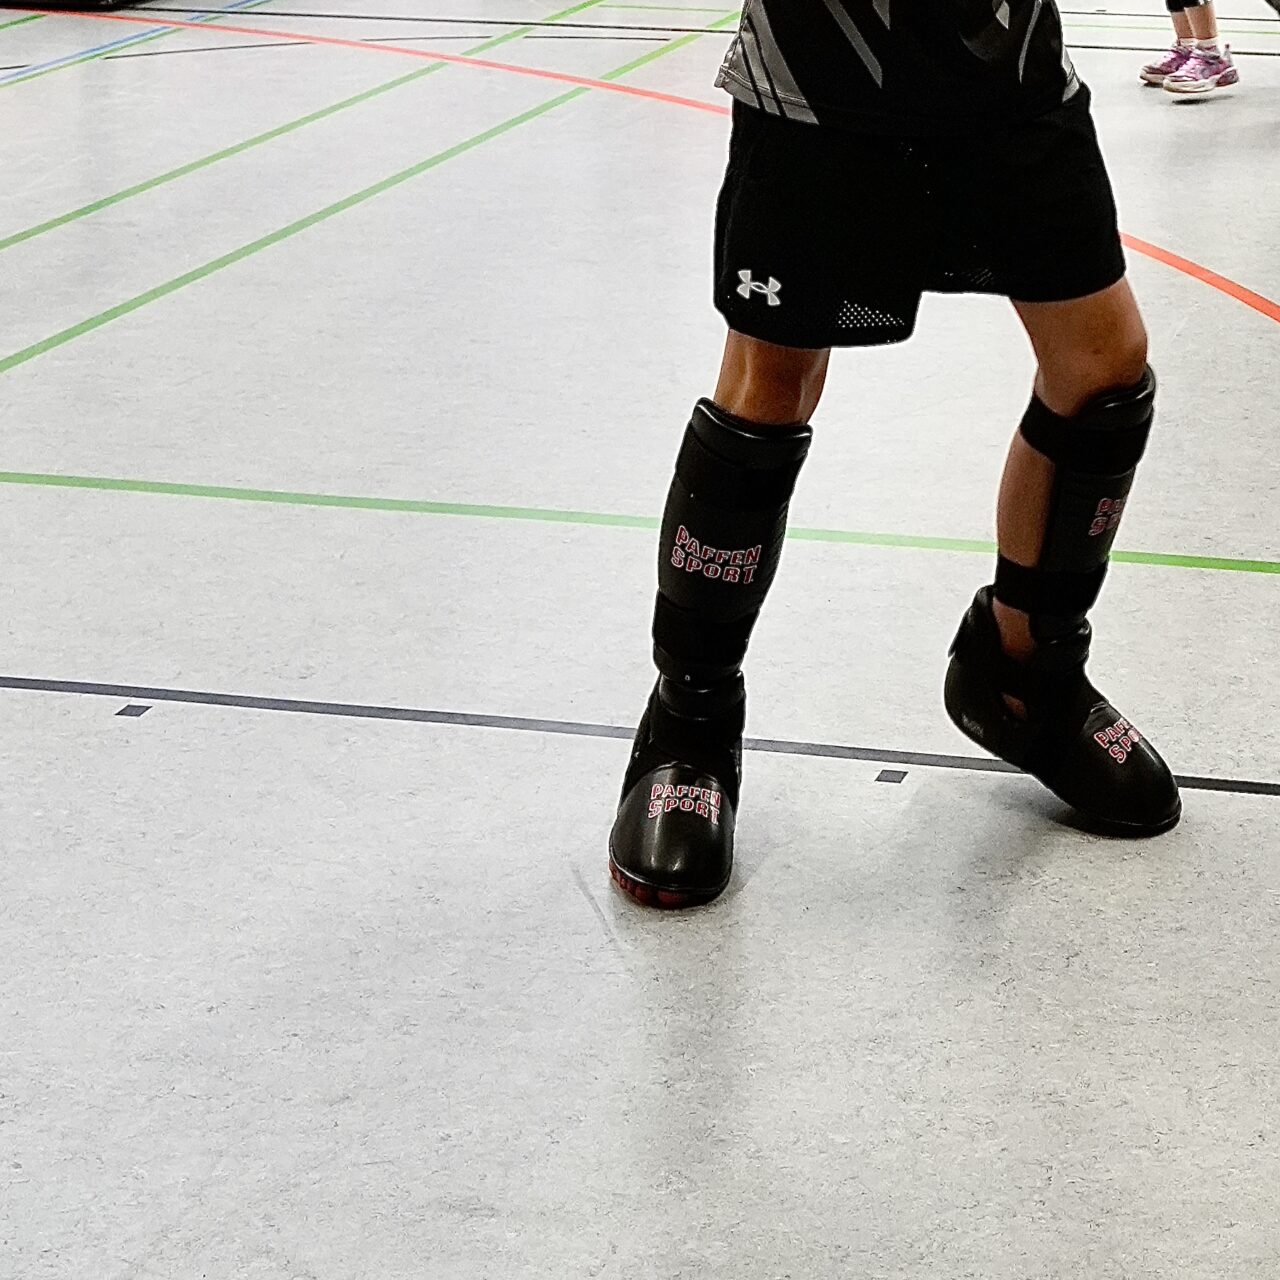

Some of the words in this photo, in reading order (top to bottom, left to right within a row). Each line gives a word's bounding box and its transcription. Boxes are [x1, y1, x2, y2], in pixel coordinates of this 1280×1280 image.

[675, 525, 762, 565] PAFFEN
[671, 546, 758, 584] SPORT
[648, 798, 720, 825] SPORT
[650, 783, 721, 808] PAFFEN
